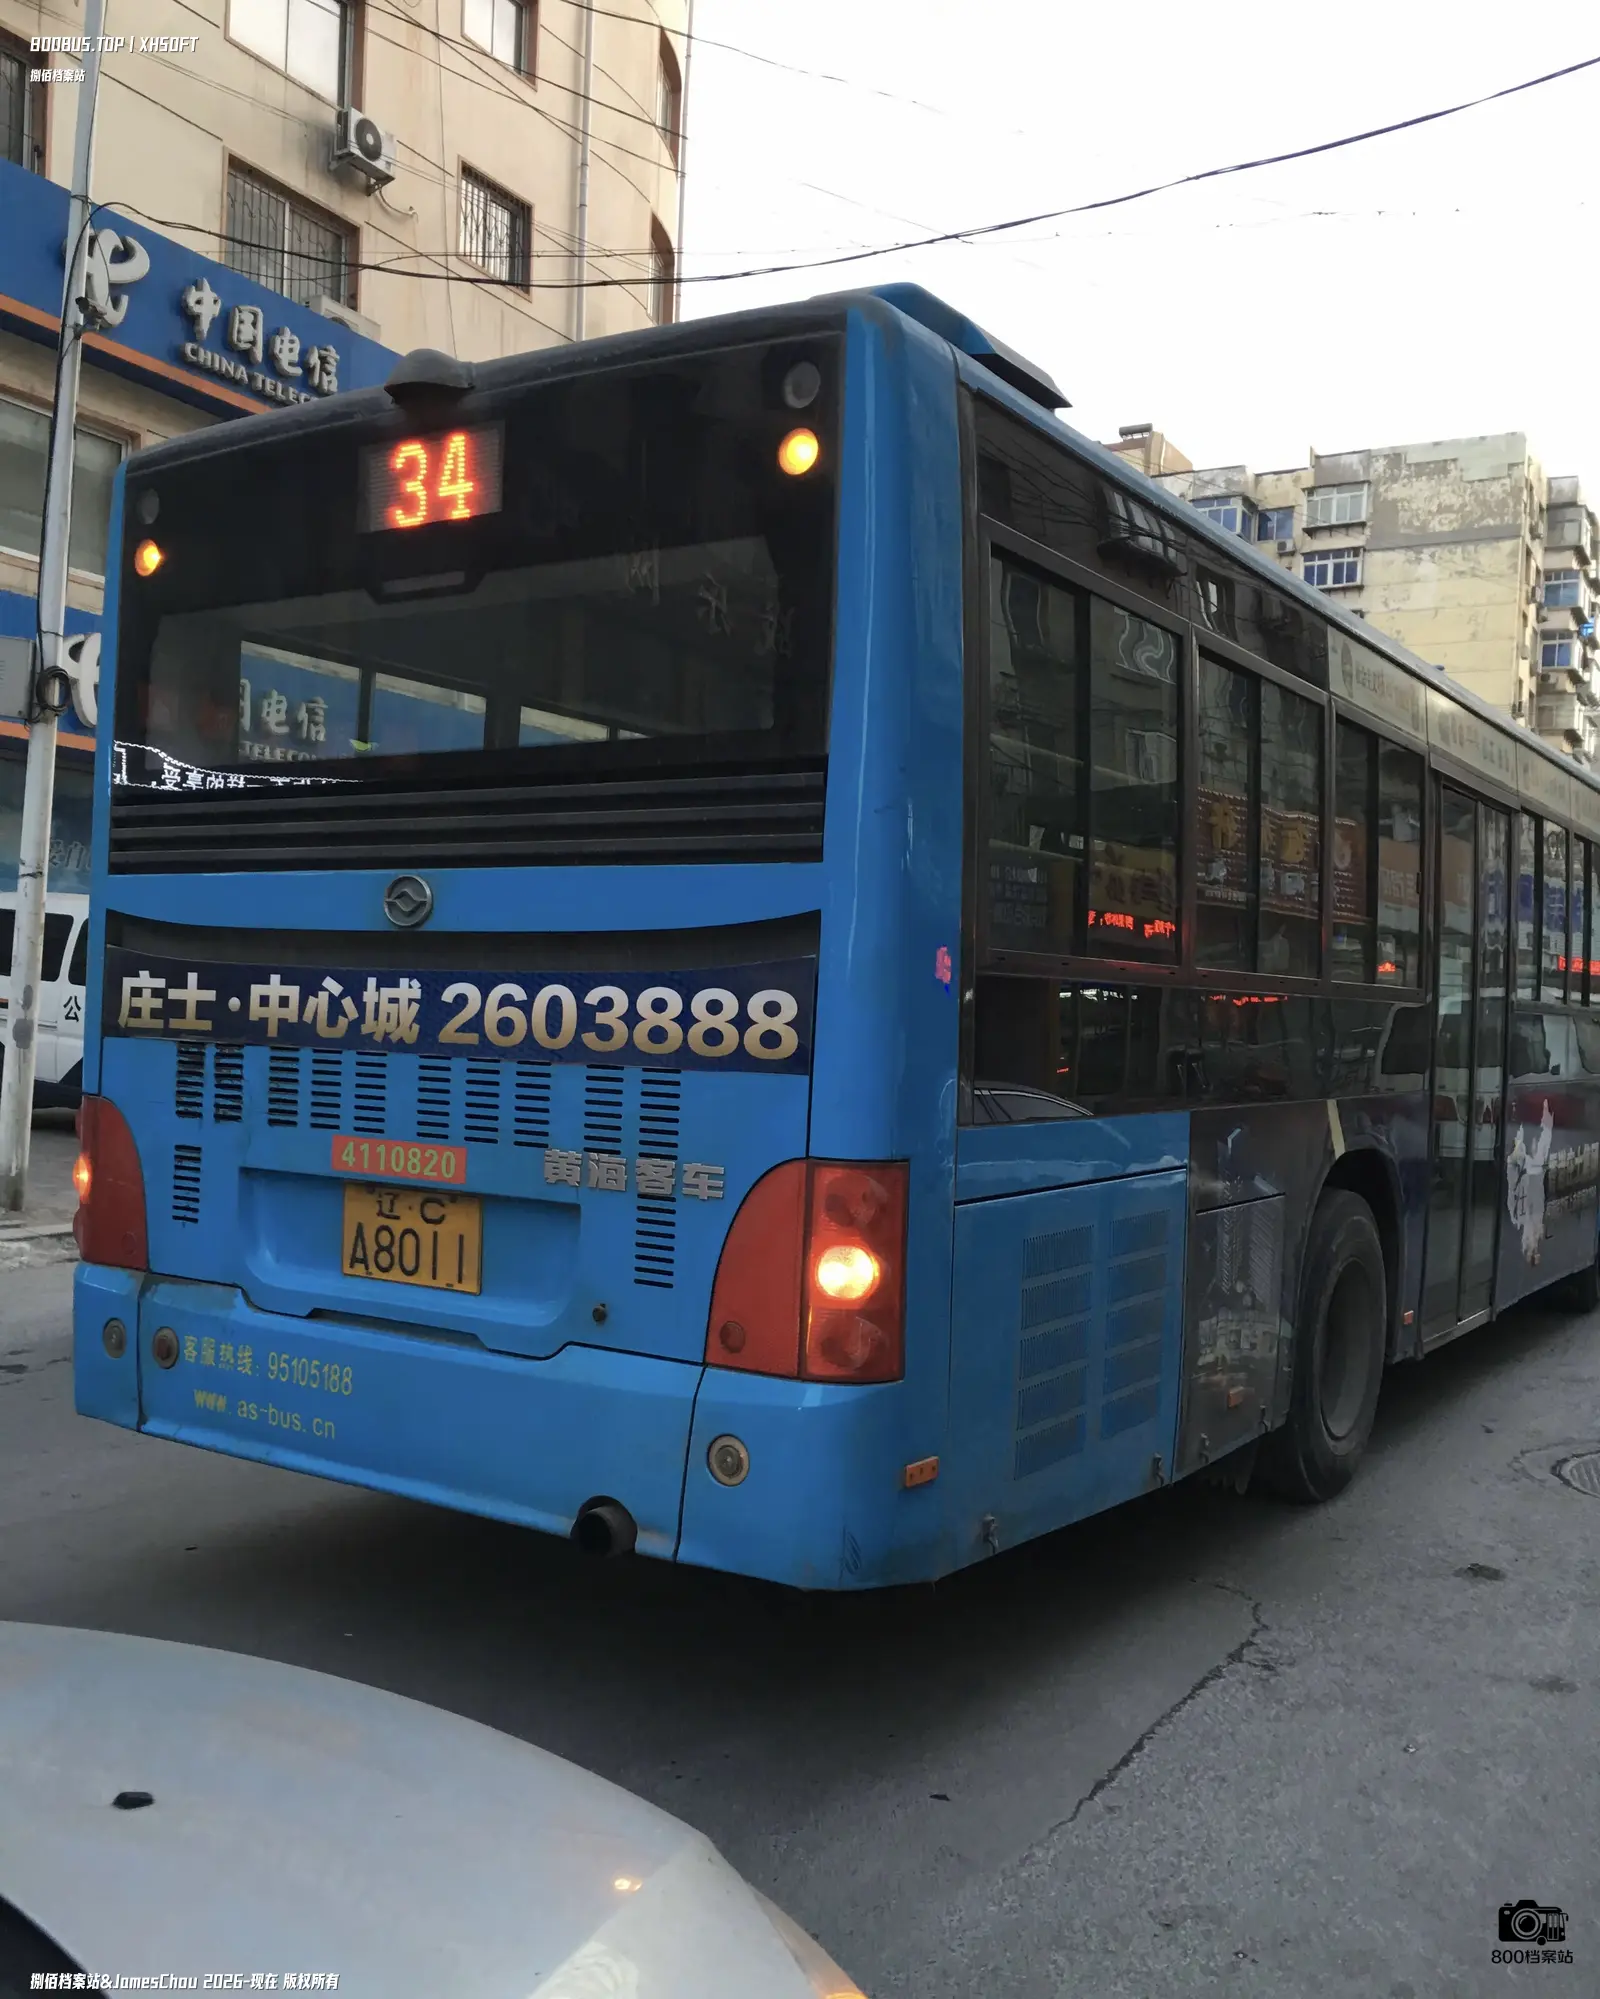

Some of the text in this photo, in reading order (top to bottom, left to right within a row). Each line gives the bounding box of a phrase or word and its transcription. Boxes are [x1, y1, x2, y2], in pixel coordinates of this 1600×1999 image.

[182, 276, 340, 396] 中国电信
[183, 341, 249, 386] CHINA
[394, 432, 475, 529] 34
[63, 995, 82, 1023] 公
[438, 982, 800, 1061] 2603888
[341, 1141, 456, 1178] 4110820
[544, 1148, 725, 1200] 黄海客车
[349, 1221, 464, 1284] A8011
[267, 1351, 353, 1396] 95105188
